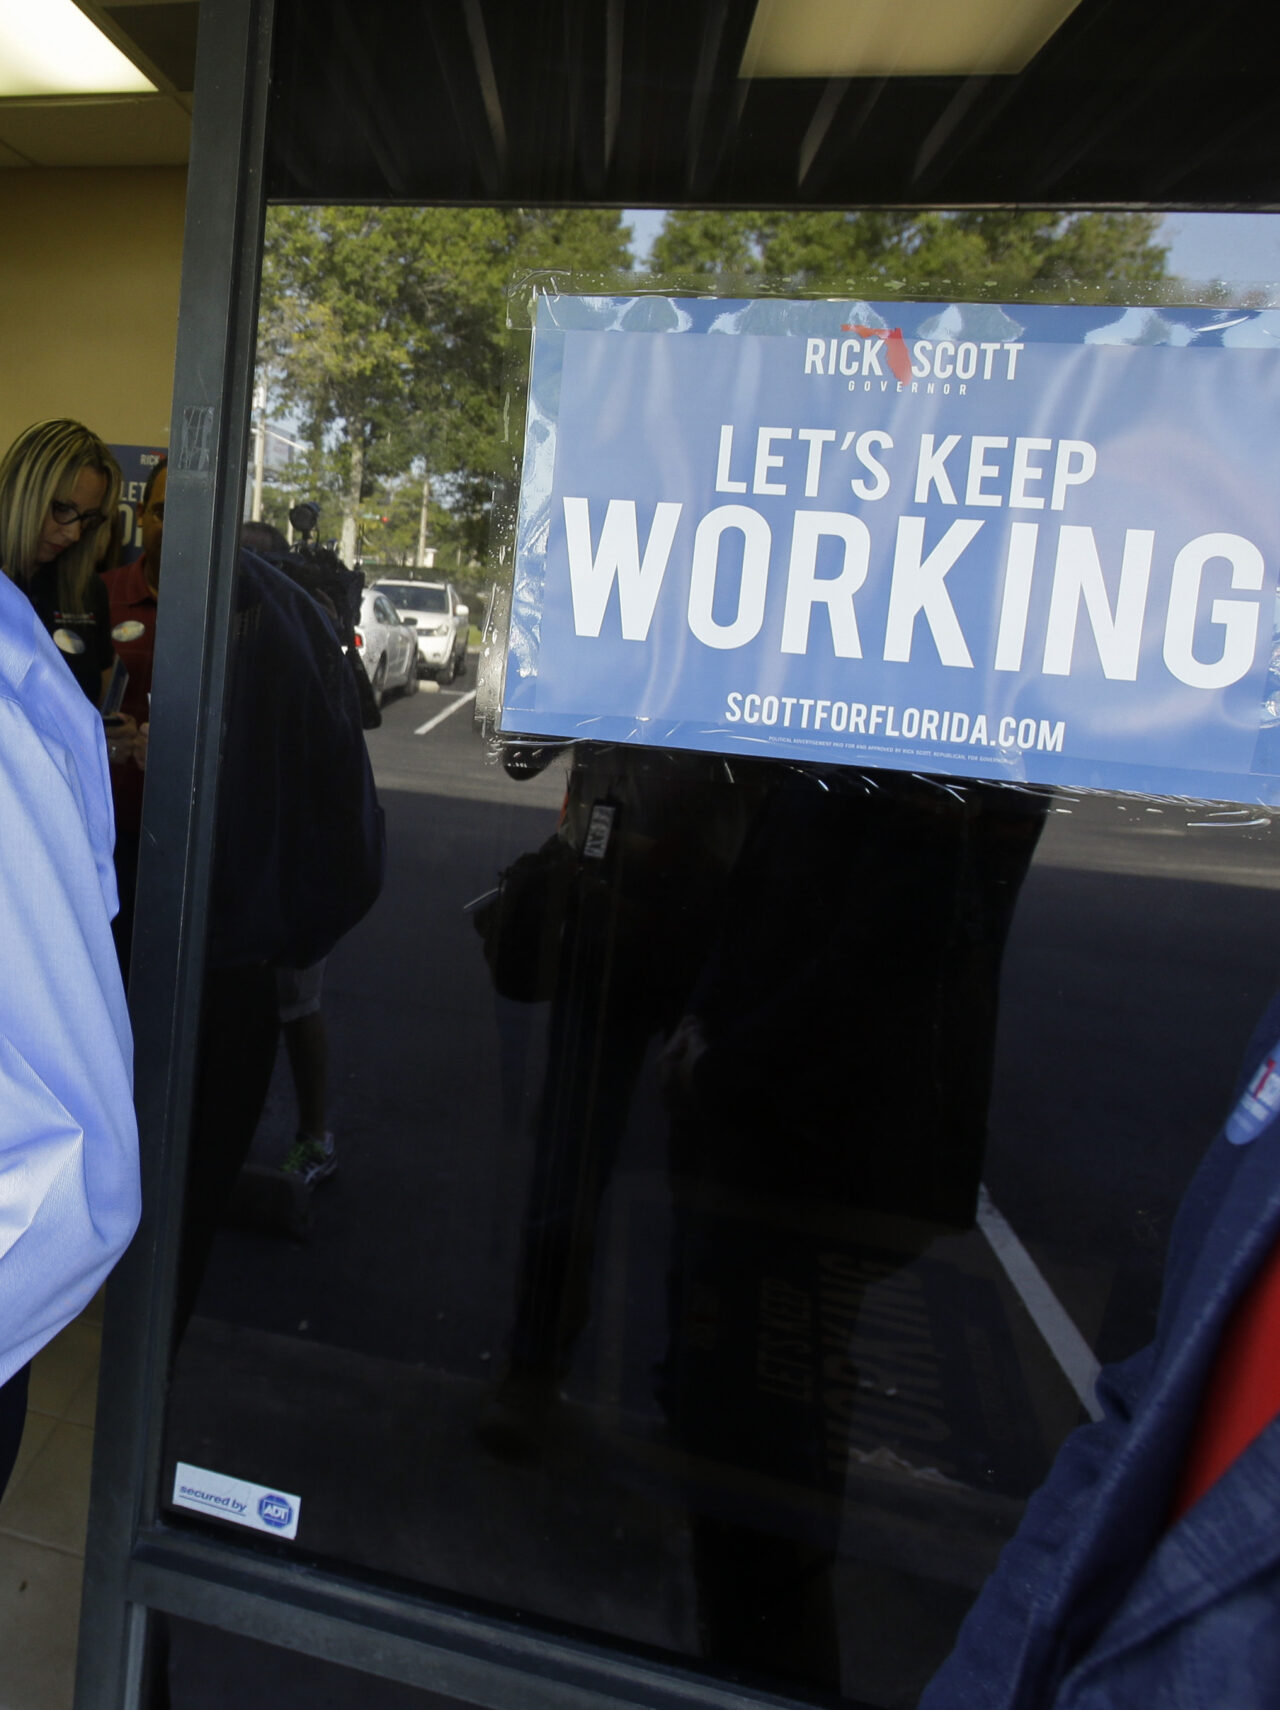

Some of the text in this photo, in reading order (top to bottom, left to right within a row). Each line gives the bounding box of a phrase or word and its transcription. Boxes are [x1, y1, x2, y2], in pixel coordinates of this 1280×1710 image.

[804, 338, 1025, 380] RICK SCOTT
[848, 380, 967, 396] GOVERNOR
[714, 425, 1098, 511] LET'S KEEP
[563, 496, 1266, 690] WORKING
[725, 691, 1066, 753] SCOTTFORFLORIDA.COM
[179, 1485, 247, 1514] secured by
[264, 1502, 290, 1521] ADT
